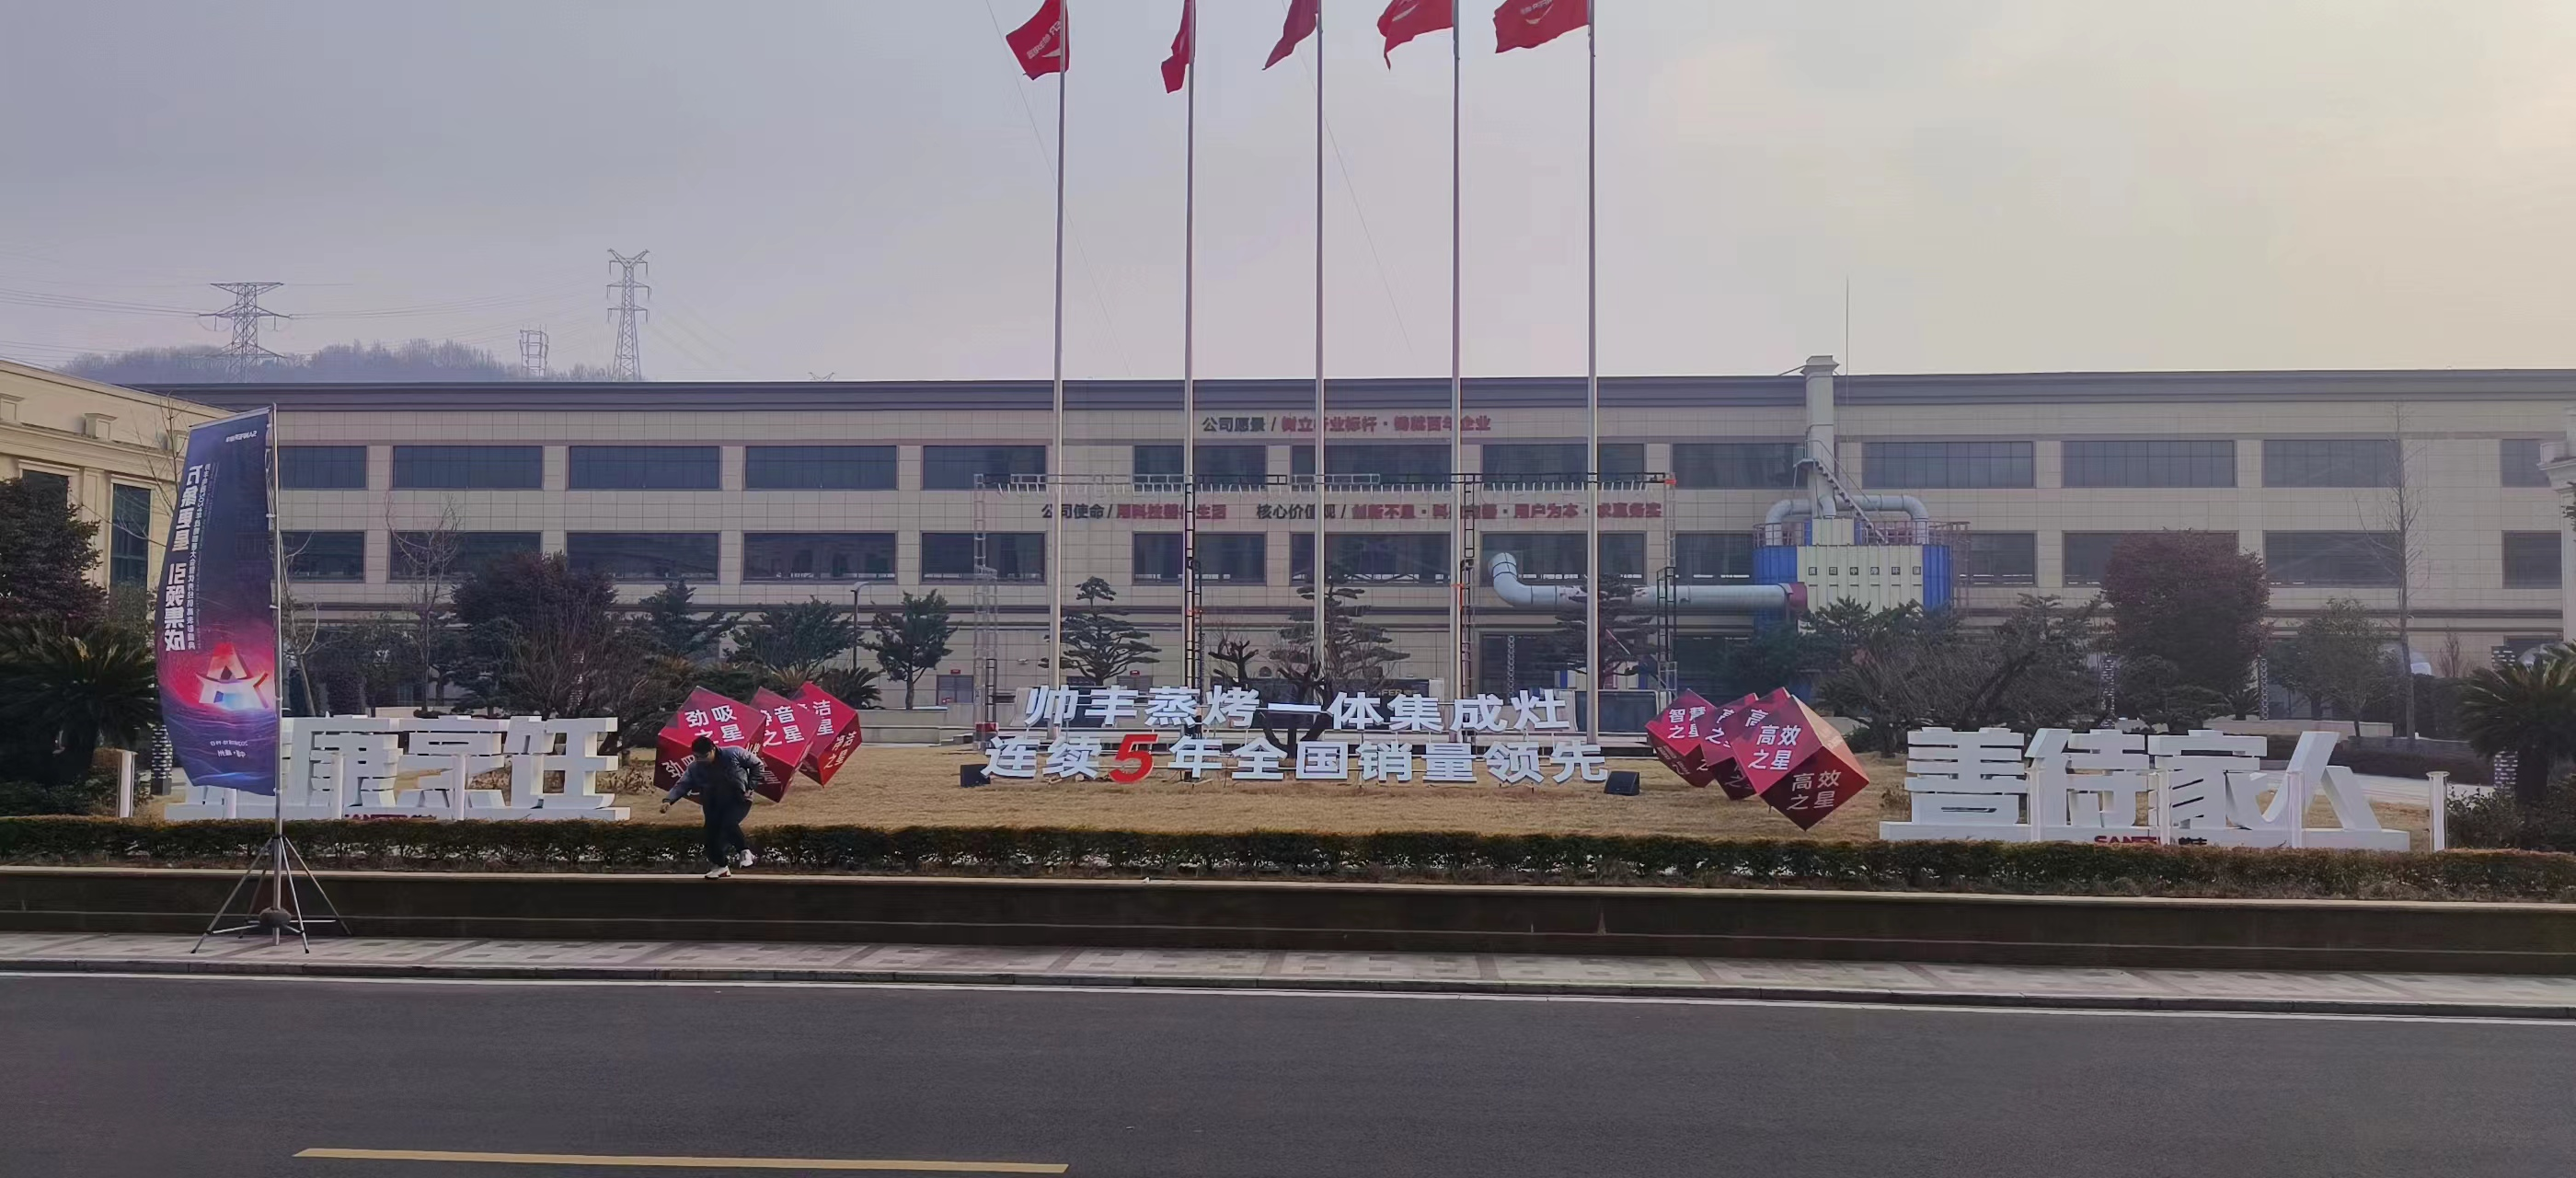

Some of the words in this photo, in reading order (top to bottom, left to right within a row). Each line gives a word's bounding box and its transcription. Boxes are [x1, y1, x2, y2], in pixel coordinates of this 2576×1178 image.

[684, 705, 738, 727] 劲吸
[1024, 684, 1570, 733] 帅丰蒸烤一体集成灶
[763, 724, 804, 747] 之星
[1705, 727, 1731, 748] 之
[1756, 724, 1801, 746] 高效
[188, 715, 619, 809] 康烹饪
[980, 733, 1608, 785] 连续5年全国销量领先
[1748, 749, 1792, 770] 之星
[1791, 768, 1842, 792] 高效
[1904, 727, 2381, 831] 善待家人
[1787, 790, 1836, 810] 之星
